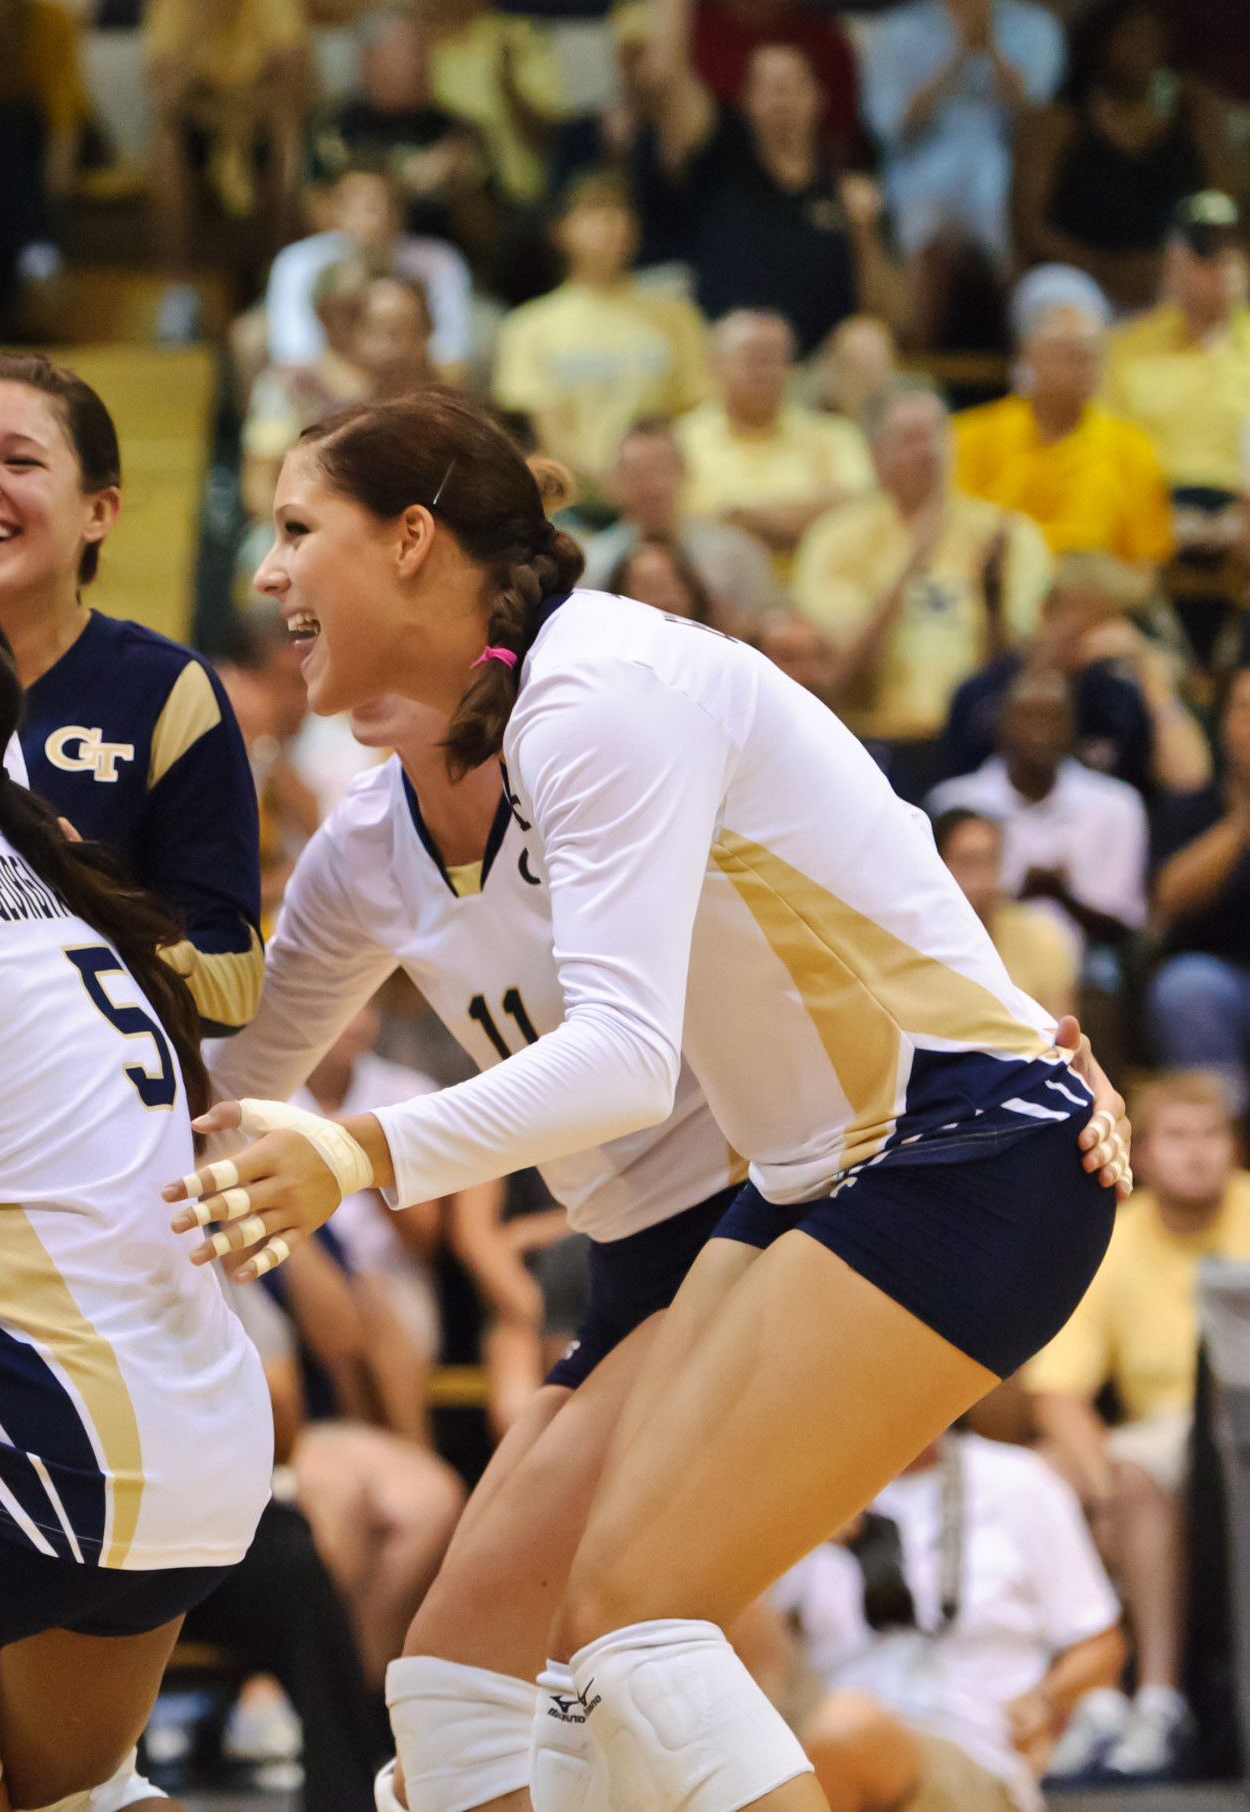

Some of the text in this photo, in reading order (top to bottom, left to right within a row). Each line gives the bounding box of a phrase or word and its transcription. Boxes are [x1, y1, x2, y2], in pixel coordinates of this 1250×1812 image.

[45, 725, 134, 782] GT
[61, 943, 178, 1113] 5
[468, 985, 540, 1062] 11
